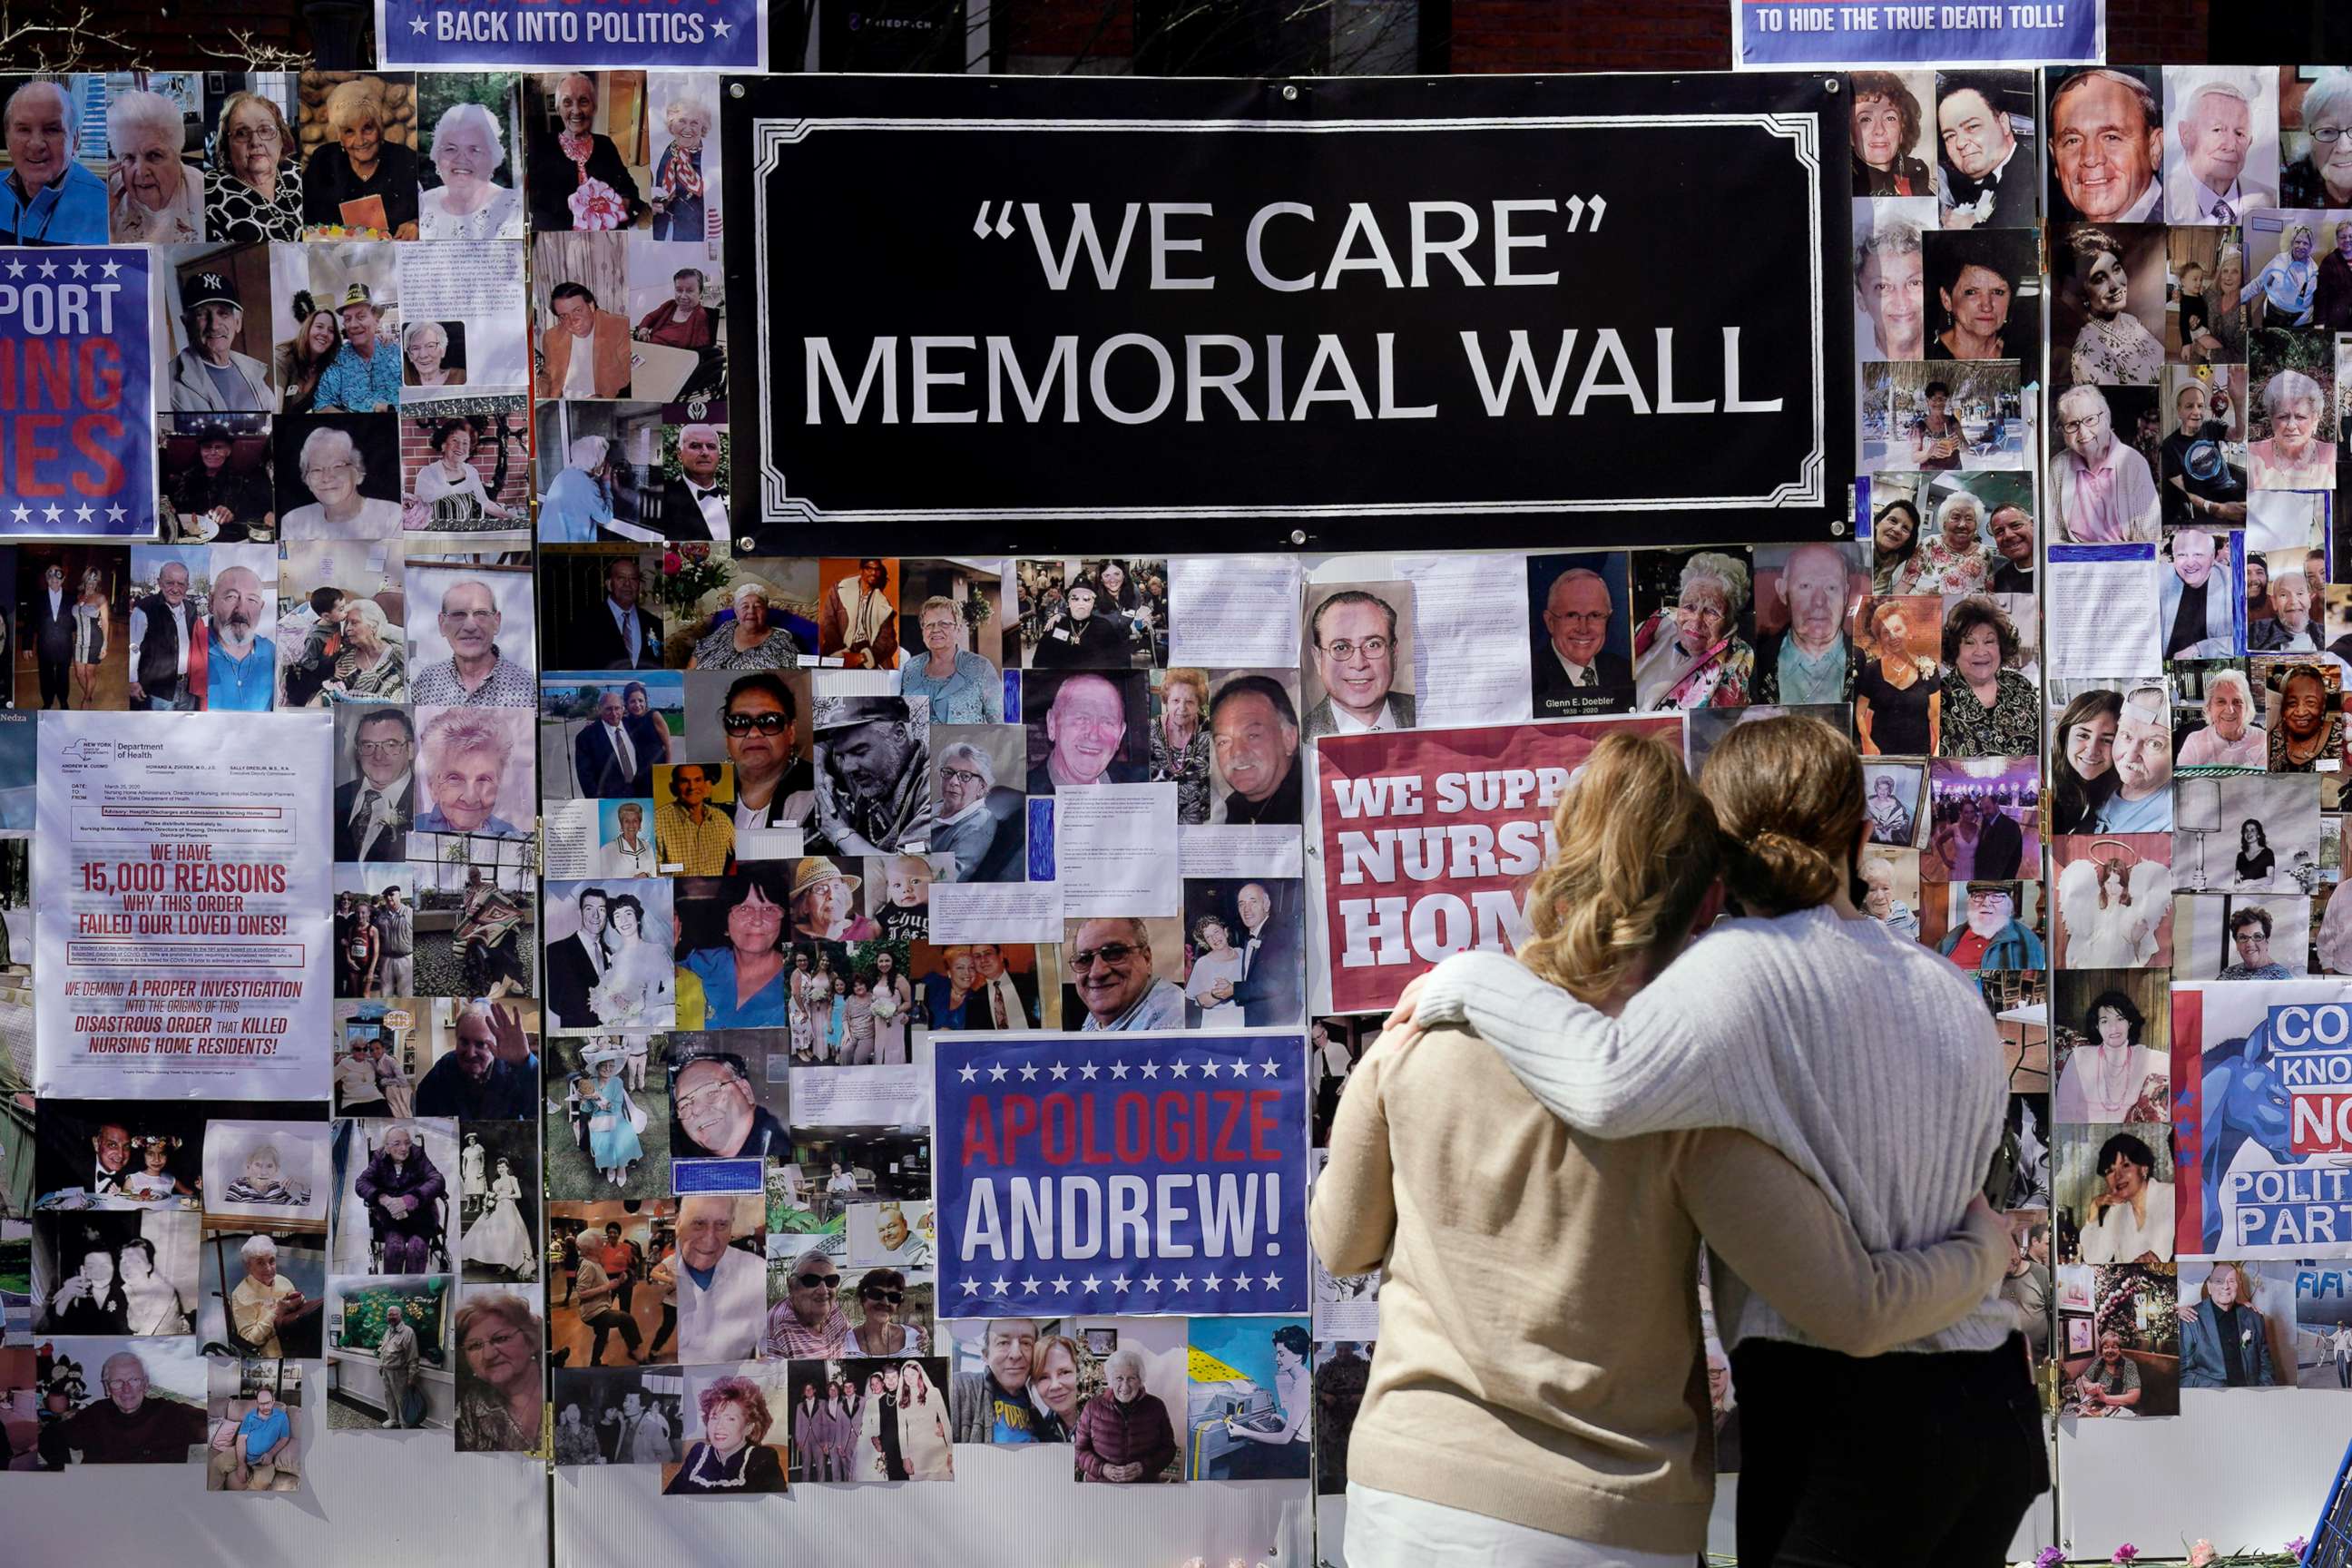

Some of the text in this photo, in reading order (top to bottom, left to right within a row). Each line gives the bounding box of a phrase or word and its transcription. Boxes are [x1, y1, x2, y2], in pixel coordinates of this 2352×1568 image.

[437, 12, 704, 43] BACK INTO POLITICS
[1757, 5, 2064, 31] TO HIDE THE TRUE DEATH TOLL!
[974, 194, 1606, 291] “WE CARE”
[805, 327, 1783, 424] MEMORIAL WALL
[1545, 700, 1570, 708] Glenn
[1583, 697, 1614, 706] Doebler
[0, 713, 27, 722] Nedza
[117, 743, 163, 751] Department
[1332, 775, 1424, 818] WE
[151, 844, 213, 862] WE HAVE
[80, 862, 287, 897] 15,000 REASONS
[123, 895, 244, 913] WHY THIS ORDER
[80, 914, 287, 936] FAILED OUR LOVED ONES!
[65, 980, 303, 998] WE DEMAND A PROPER INVESTIGATION
[124, 1000, 240, 1014] INTO THE ORIGINS OF THIS
[74, 1015, 288, 1034] DISASTROUS ORDER THAT KILLED
[89, 1036, 278, 1055] NURSING HOME RESIDENTS!
[963, 1091, 1282, 1167] APOLOGIZE
[962, 1172, 1280, 1261] ANDREW!
